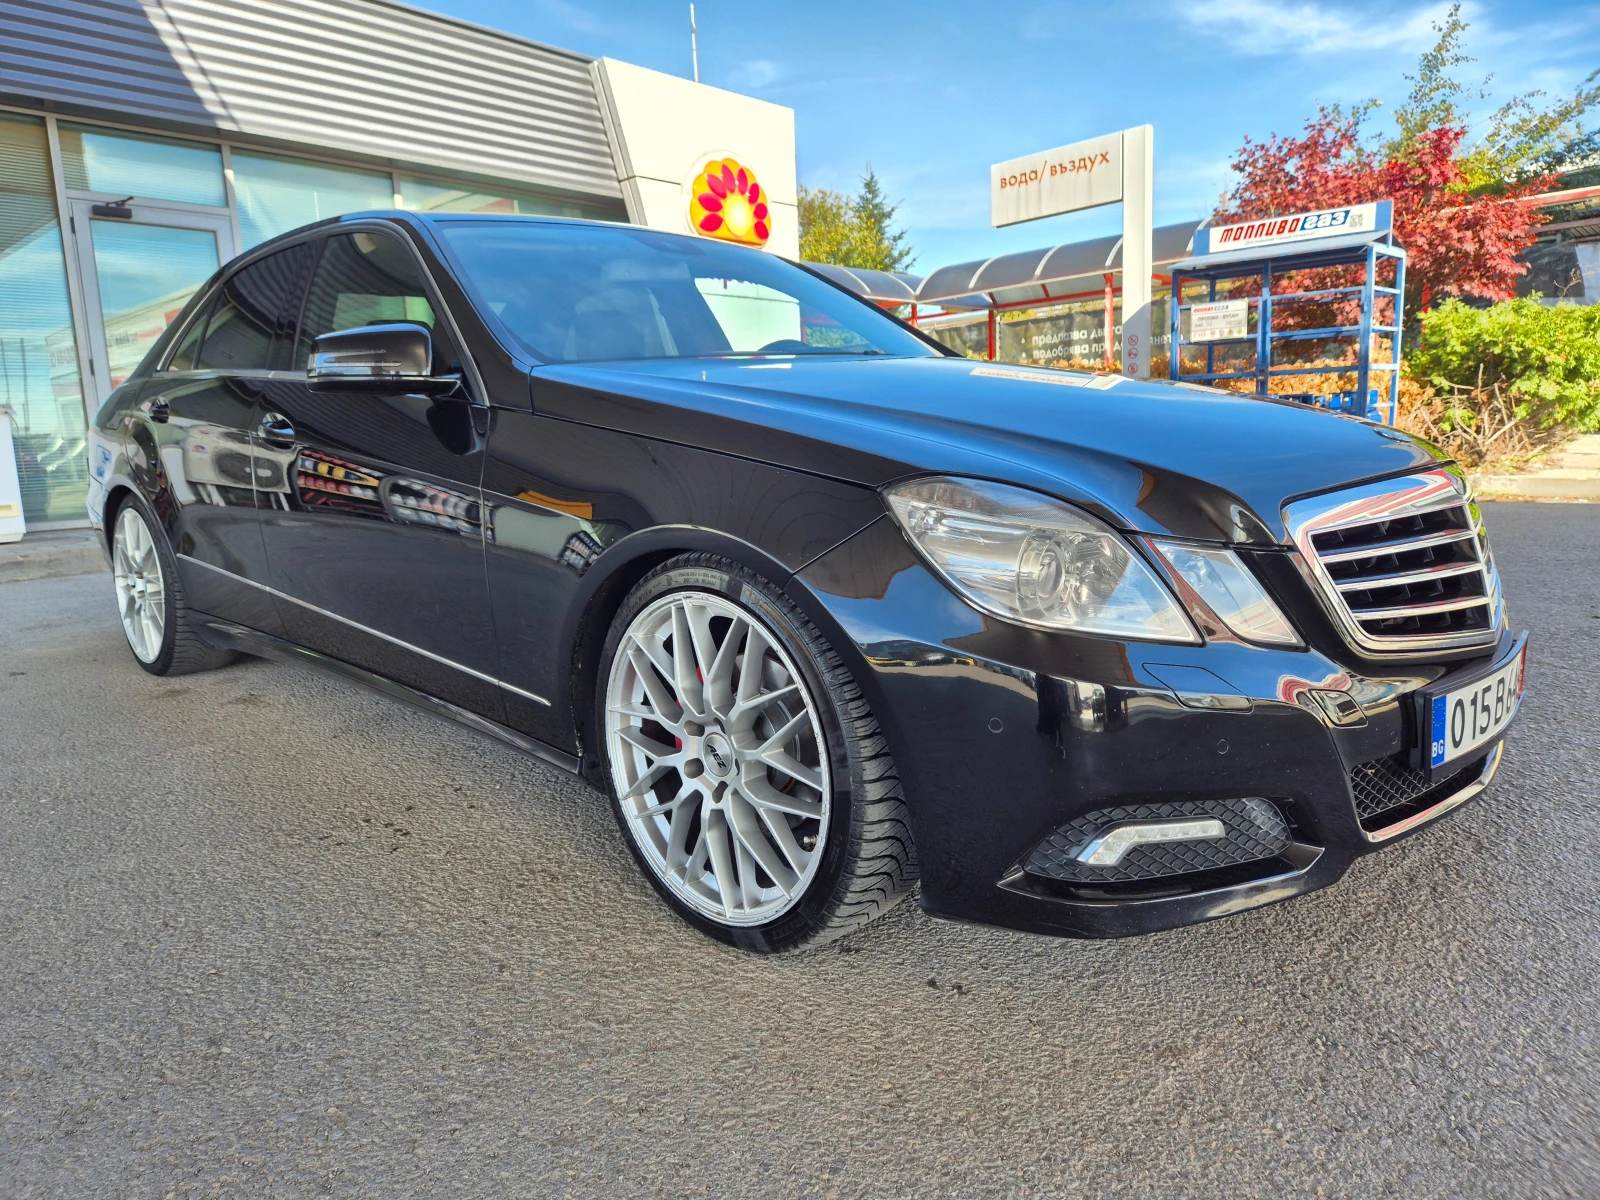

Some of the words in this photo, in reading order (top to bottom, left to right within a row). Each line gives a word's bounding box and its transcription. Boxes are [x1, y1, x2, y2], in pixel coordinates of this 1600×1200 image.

[1000, 151, 1110, 189] вода/въздух
[1031, 329, 1088, 348] предпазва
[1032, 343, 1090, 359] подобрява
[1431, 739, 1444, 758] BG
